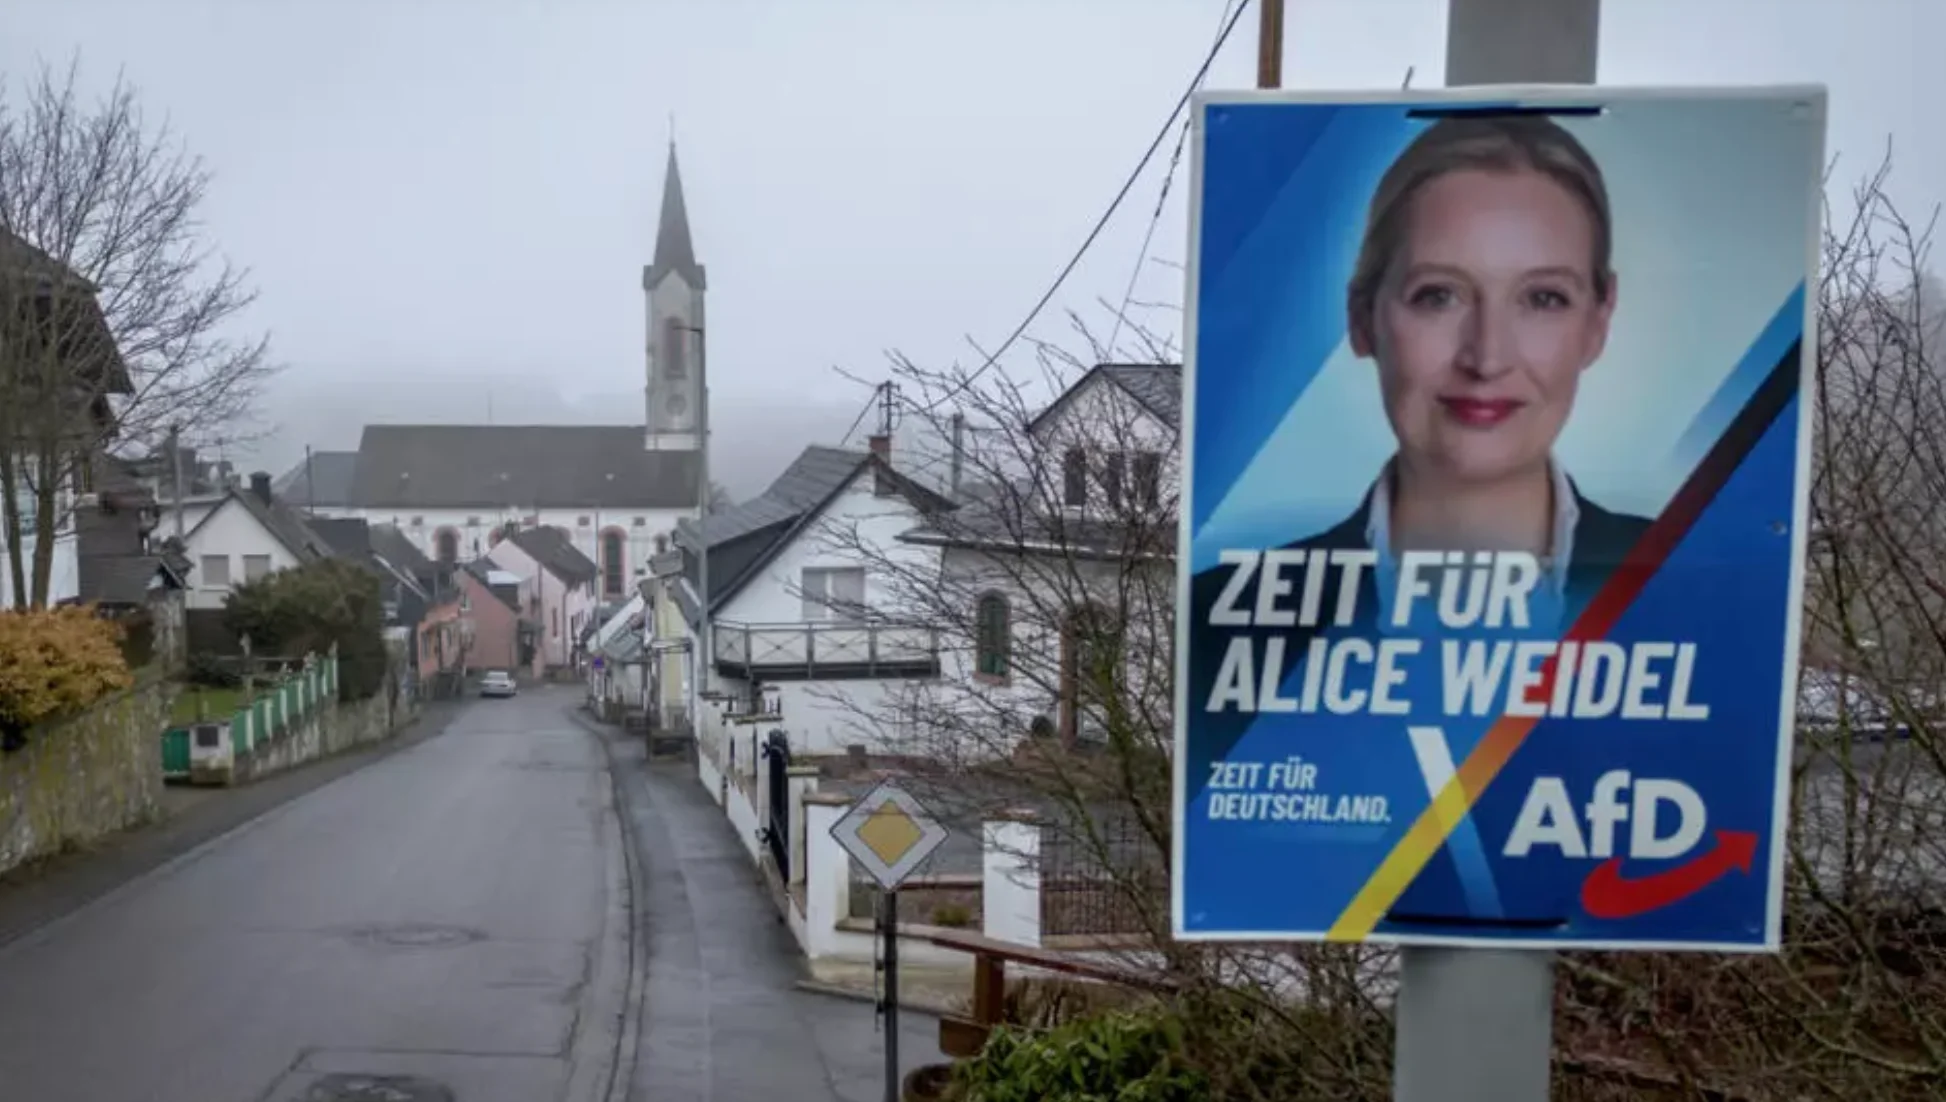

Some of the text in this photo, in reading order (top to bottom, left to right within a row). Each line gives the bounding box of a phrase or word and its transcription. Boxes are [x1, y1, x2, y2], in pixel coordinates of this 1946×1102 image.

[1208, 549, 1379, 626] ZEIT
[1206, 636, 1710, 720] ALICE WEIDEL
[1208, 756, 1317, 790] ZEIT FÜR
[1208, 793, 1391, 823] DEUTSCHLAND.
[1503, 769, 1707, 860] AfD
